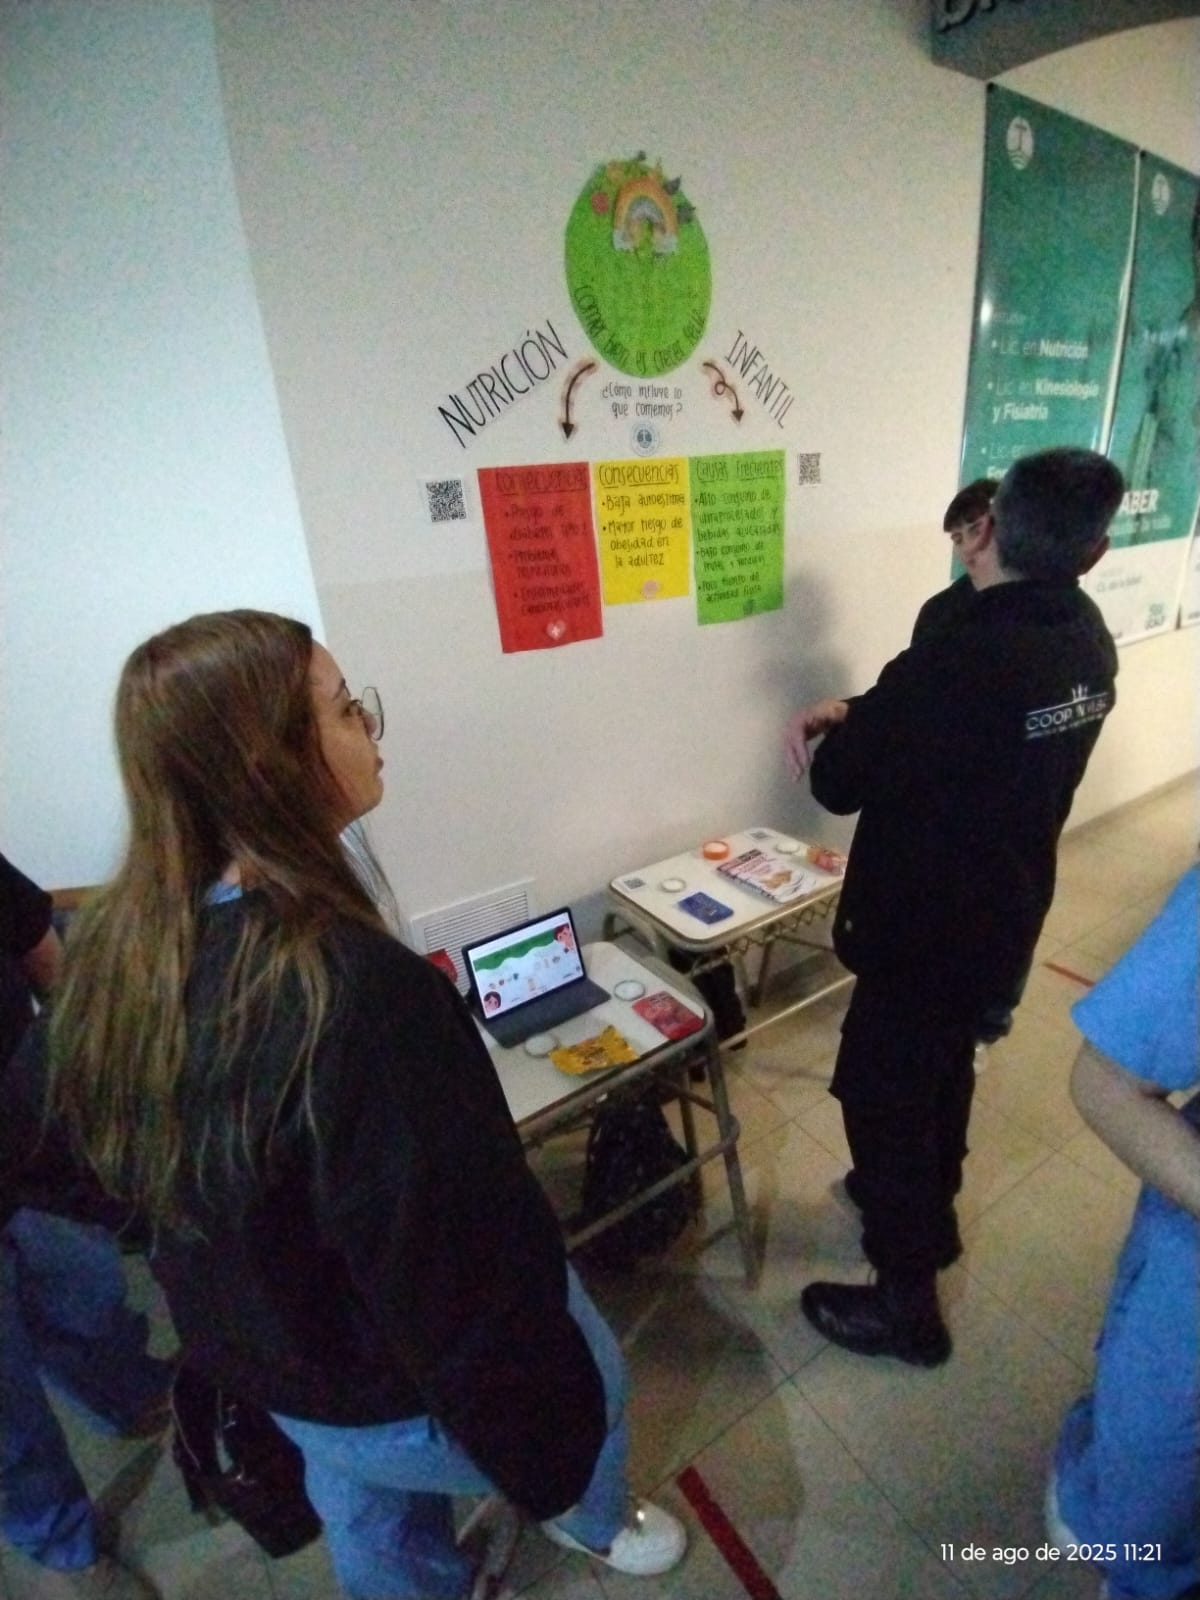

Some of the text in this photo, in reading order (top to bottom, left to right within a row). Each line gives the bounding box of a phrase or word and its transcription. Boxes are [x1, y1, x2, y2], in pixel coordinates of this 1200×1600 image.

[1039, 338, 1089, 359] Nutrición
[438, 320, 568, 448] NUTRICIÓN
[724, 329, 795, 429] INFANTIL
[639, 384, 669, 399] influye
[674, 387, 683, 399] lo
[612, 402, 629, 419] que
[993, 403, 1048, 424] y Fisiatría
[599, 464, 681, 487] Consecuencias
[606, 493, 685, 516] Baja autoestima
[1117, 489, 1159, 515] ABER
[640, 518, 667, 534] riesgo
[671, 517, 683, 528] de
[610, 536, 670, 552] obesidad en
[615, 554, 623, 568] la
[1025, 707, 1073, 731] COOP
